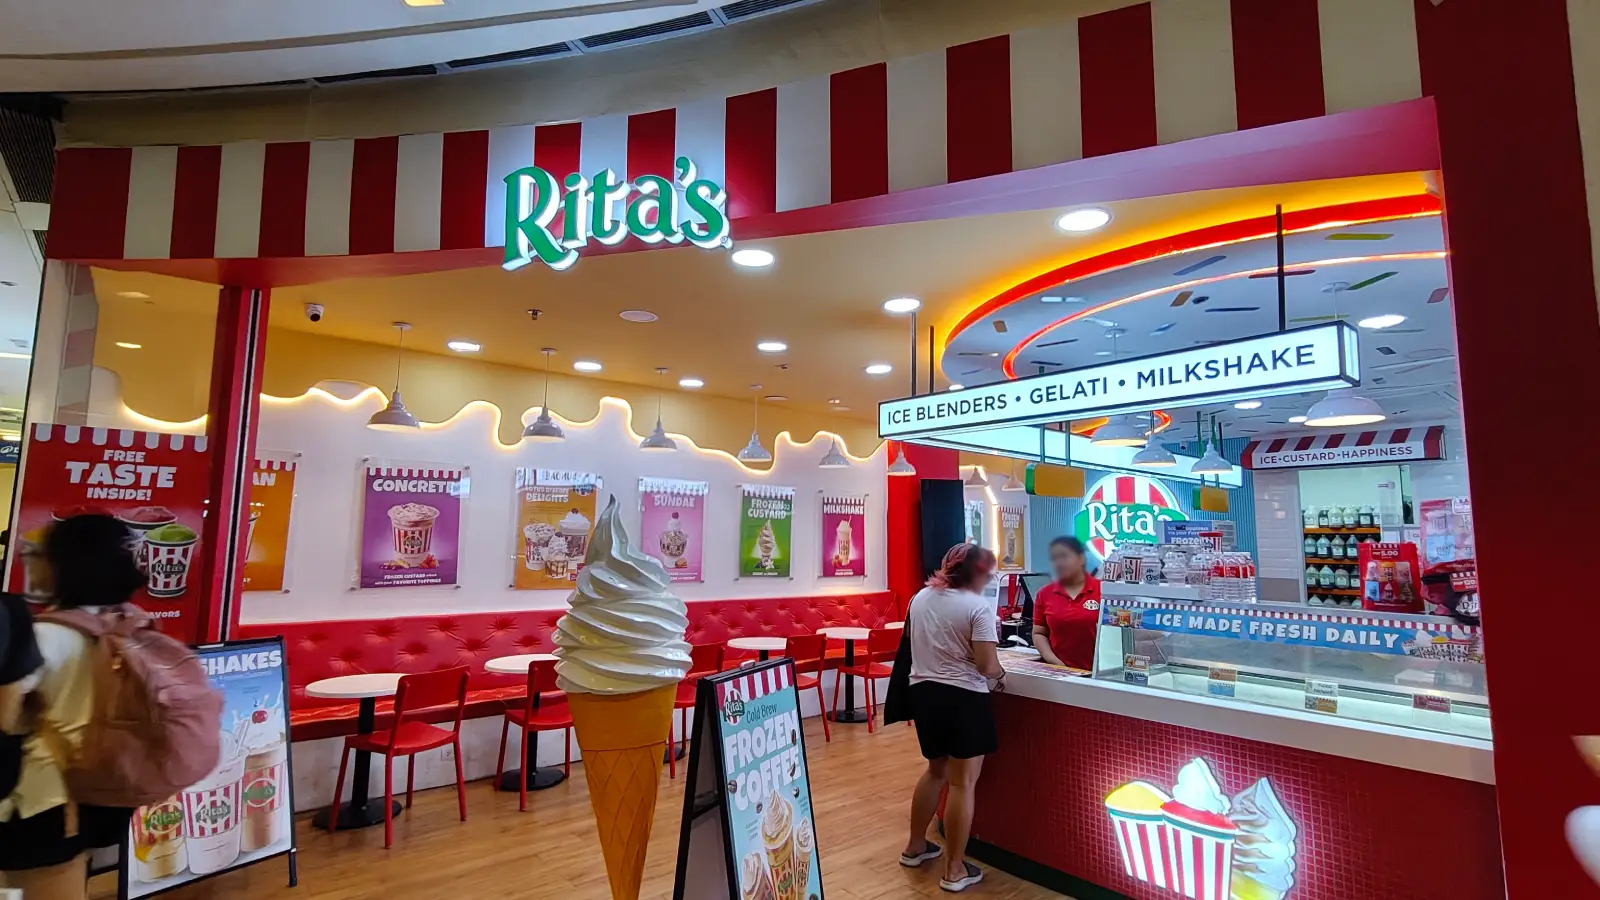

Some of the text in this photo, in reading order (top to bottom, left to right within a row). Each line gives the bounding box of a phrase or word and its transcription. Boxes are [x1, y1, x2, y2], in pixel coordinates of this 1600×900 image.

[502, 156, 733, 271] Rita's
[887, 344, 1315, 425] ICE BLENDERS GELATI MILKSHAKE
[103, 450, 145, 462] FREE
[1260, 447, 1412, 465] ICE CUSTARD HAPPINESS
[65, 461, 177, 488] TASTE
[86, 487, 152, 501] INSIDE!
[653, 495, 695, 508] SUNDAE
[747, 509, 786, 519] CUSTARD
[823, 504, 864, 515] MILKSHAKE
[1171, 536, 1200, 544] FROZE
[1155, 613, 1399, 649] ICE MADE FRESH DAILY
[725, 700, 743, 716] Rita's
[746, 703, 778, 724] Cold Brew
[725, 709, 799, 776] FROZEN
[734, 747, 802, 812] COFFEE
[200, 805, 228, 821] Rita's
